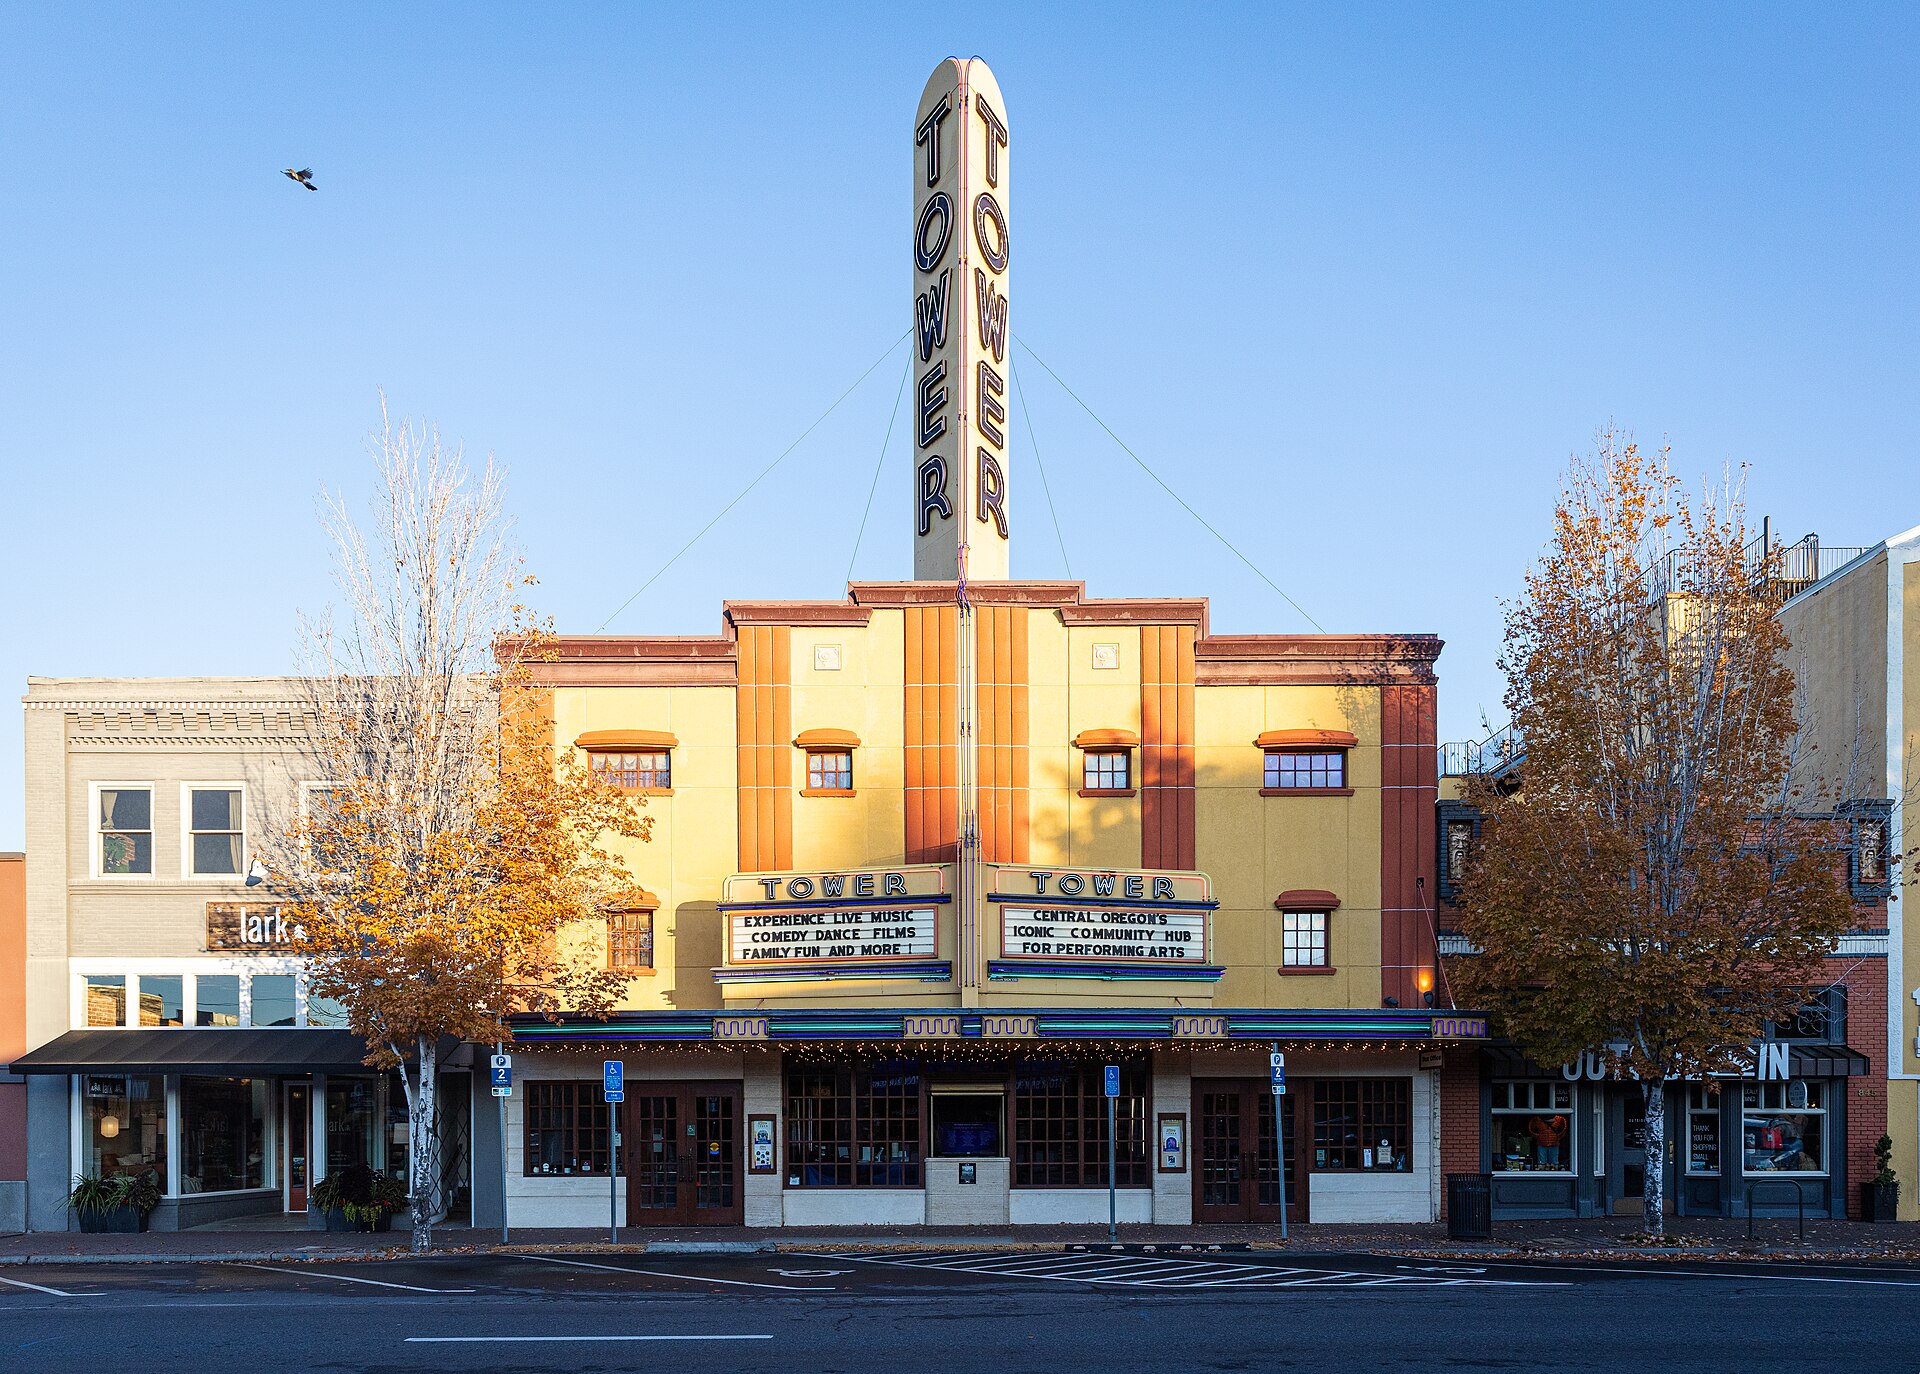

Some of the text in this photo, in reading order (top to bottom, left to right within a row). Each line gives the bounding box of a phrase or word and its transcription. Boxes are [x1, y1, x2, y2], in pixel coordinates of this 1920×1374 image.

[914, 92, 953, 539] TOWER
[973, 92, 1010, 540] TOWER
[762, 873, 907, 900] TOWER
[1031, 872, 1175, 899] TOWER
[240, 906, 290, 943] lark
[744, 910, 914, 927] EXPERIENCE LIVE MUSIC
[1033, 910, 1168, 925] CENTRAL OREGON'S
[751, 927, 916, 943] COMEDY DANCE FILMS
[1013, 926, 1191, 942] ICONIC COMMUNITY HUB
[743, 947, 791, 959] FAMILY
[794, 946, 821, 957] FUN
[829, 945, 855, 956] AND
[861, 943, 900, 955] MORE
[1023, 942, 1185, 958] FOR PERFORMING ARTS
[1758, 1043, 1789, 1080] IN
[498, 1069, 505, 1079] 2
[1275, 1067, 1281, 1078] 2
[1858, 1088, 1876, 1097] 845
[1692, 1143, 1717, 1151] SHOPPING
